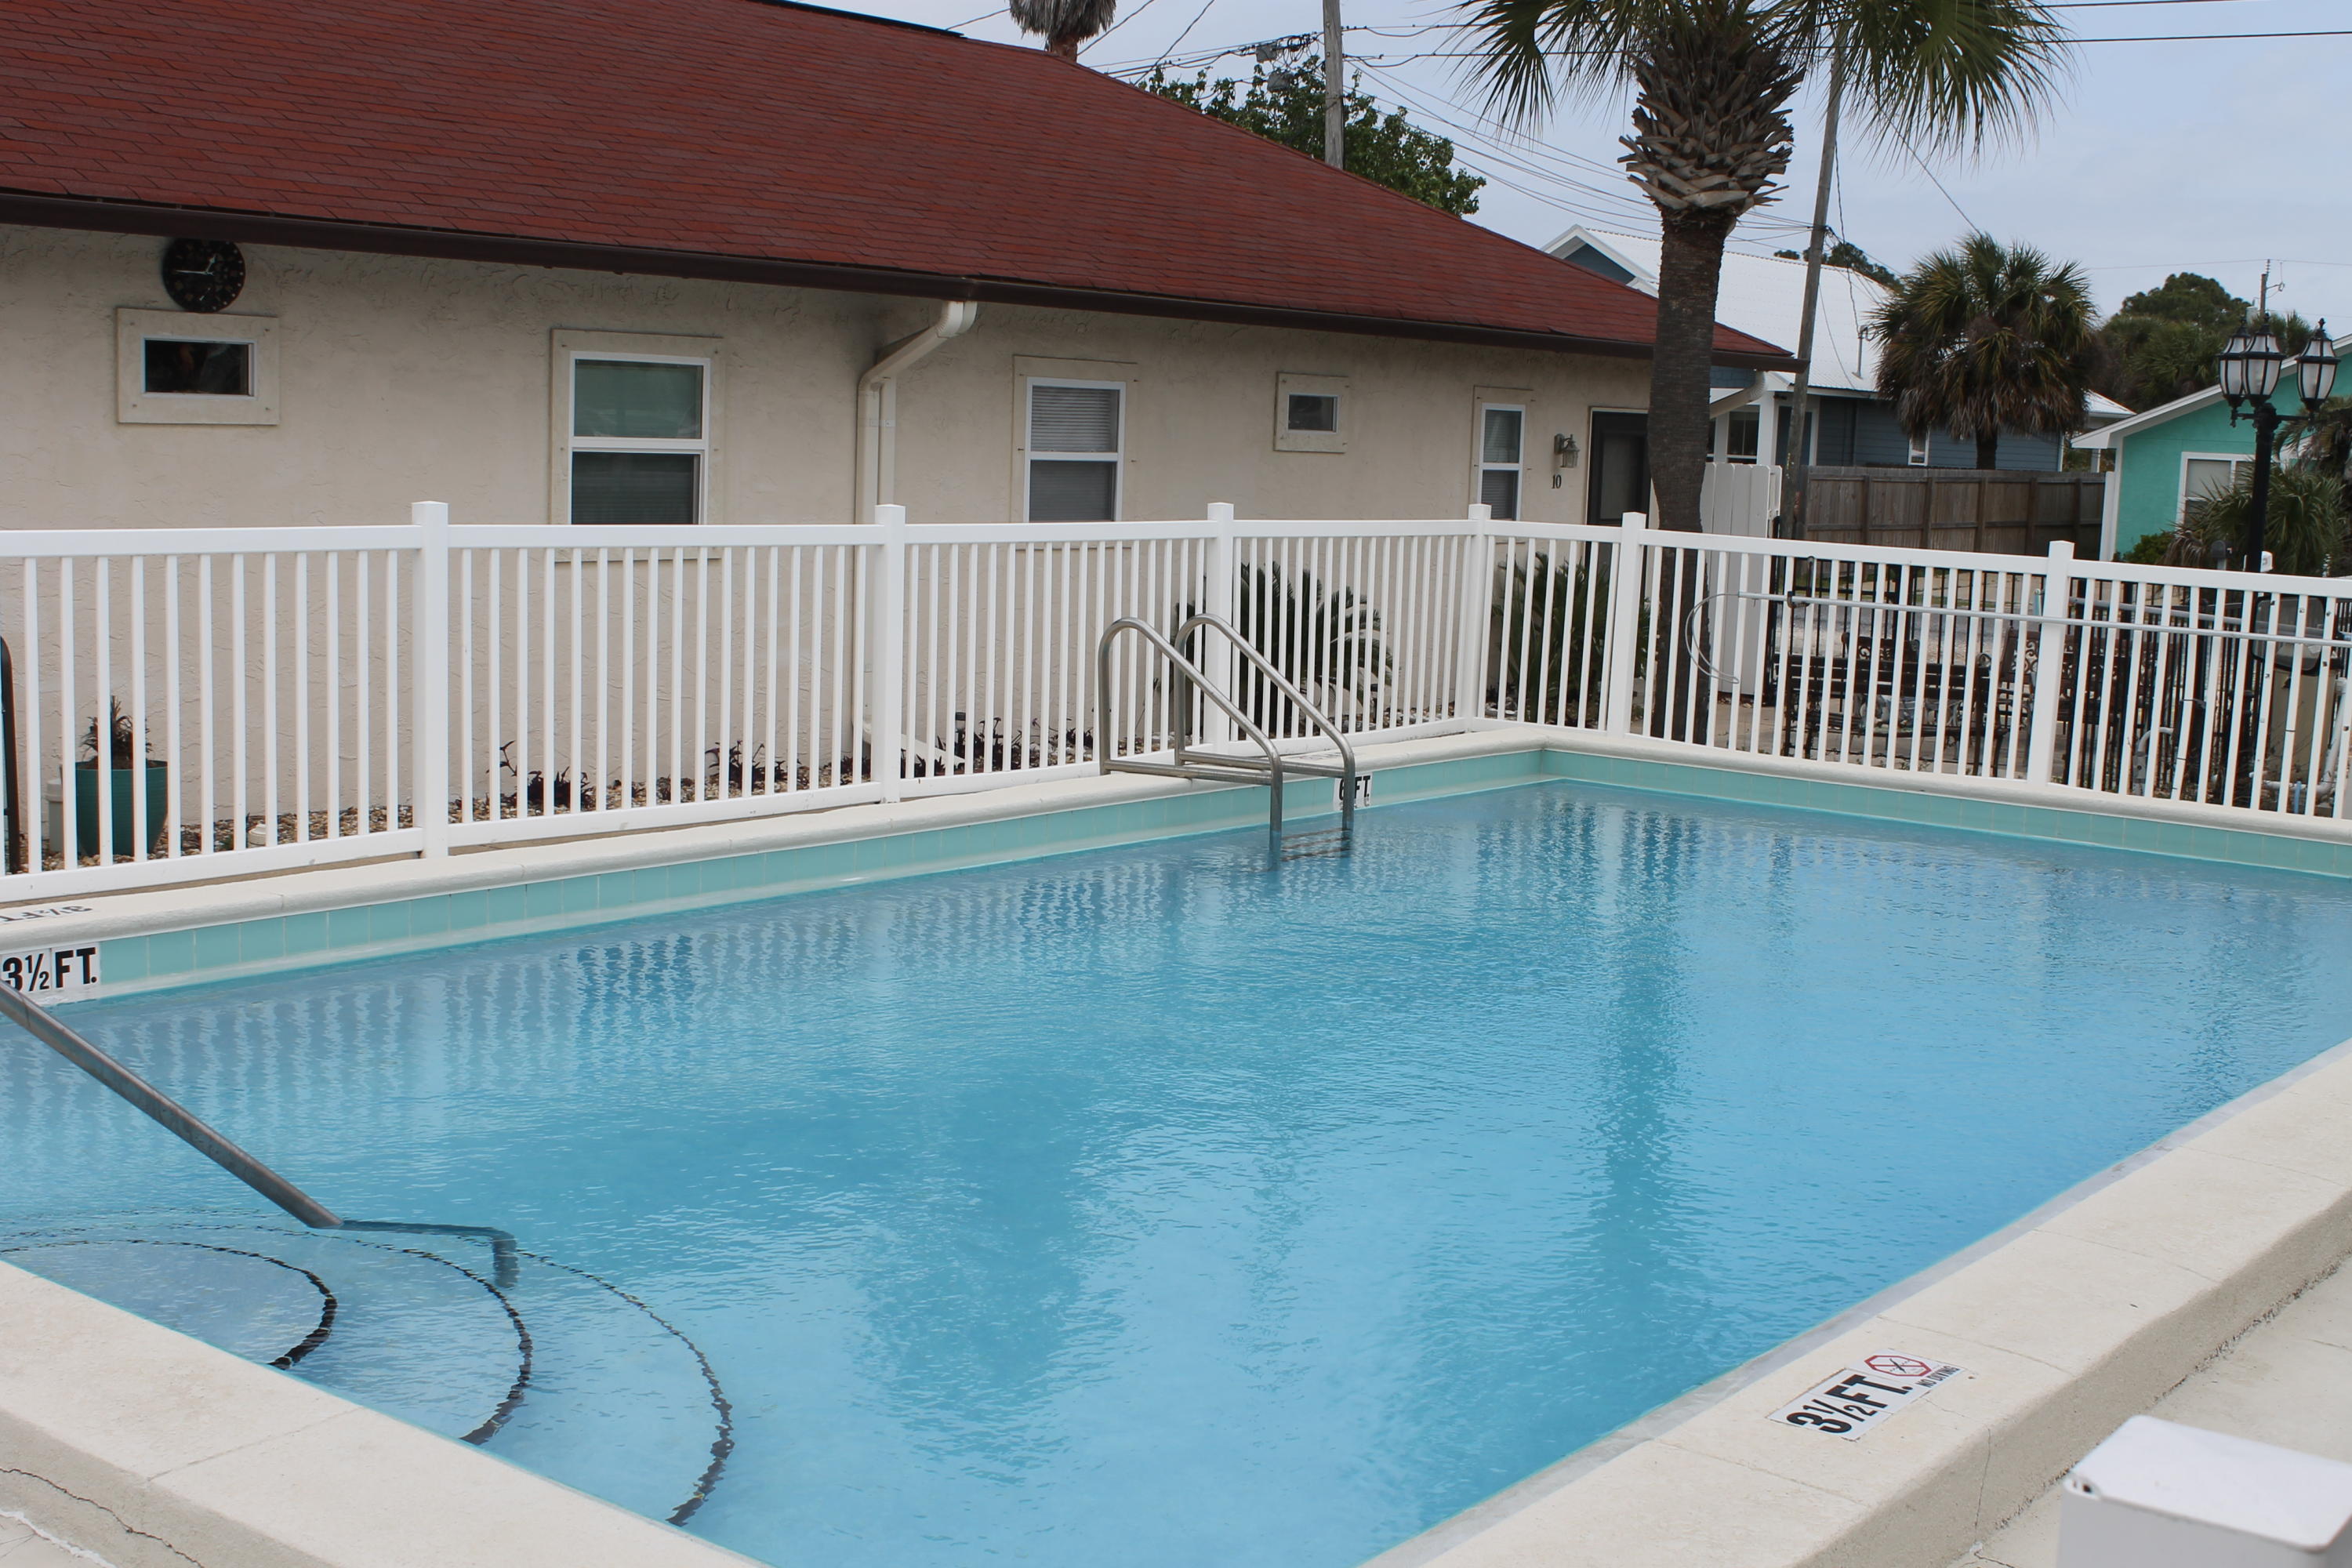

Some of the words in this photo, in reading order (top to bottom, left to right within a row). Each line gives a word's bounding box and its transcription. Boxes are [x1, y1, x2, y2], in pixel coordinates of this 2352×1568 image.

[1552, 474, 1562, 488] 10
[1915, 1378, 1936, 1388] NO
[1926, 1366, 1960, 1381] DIVING
